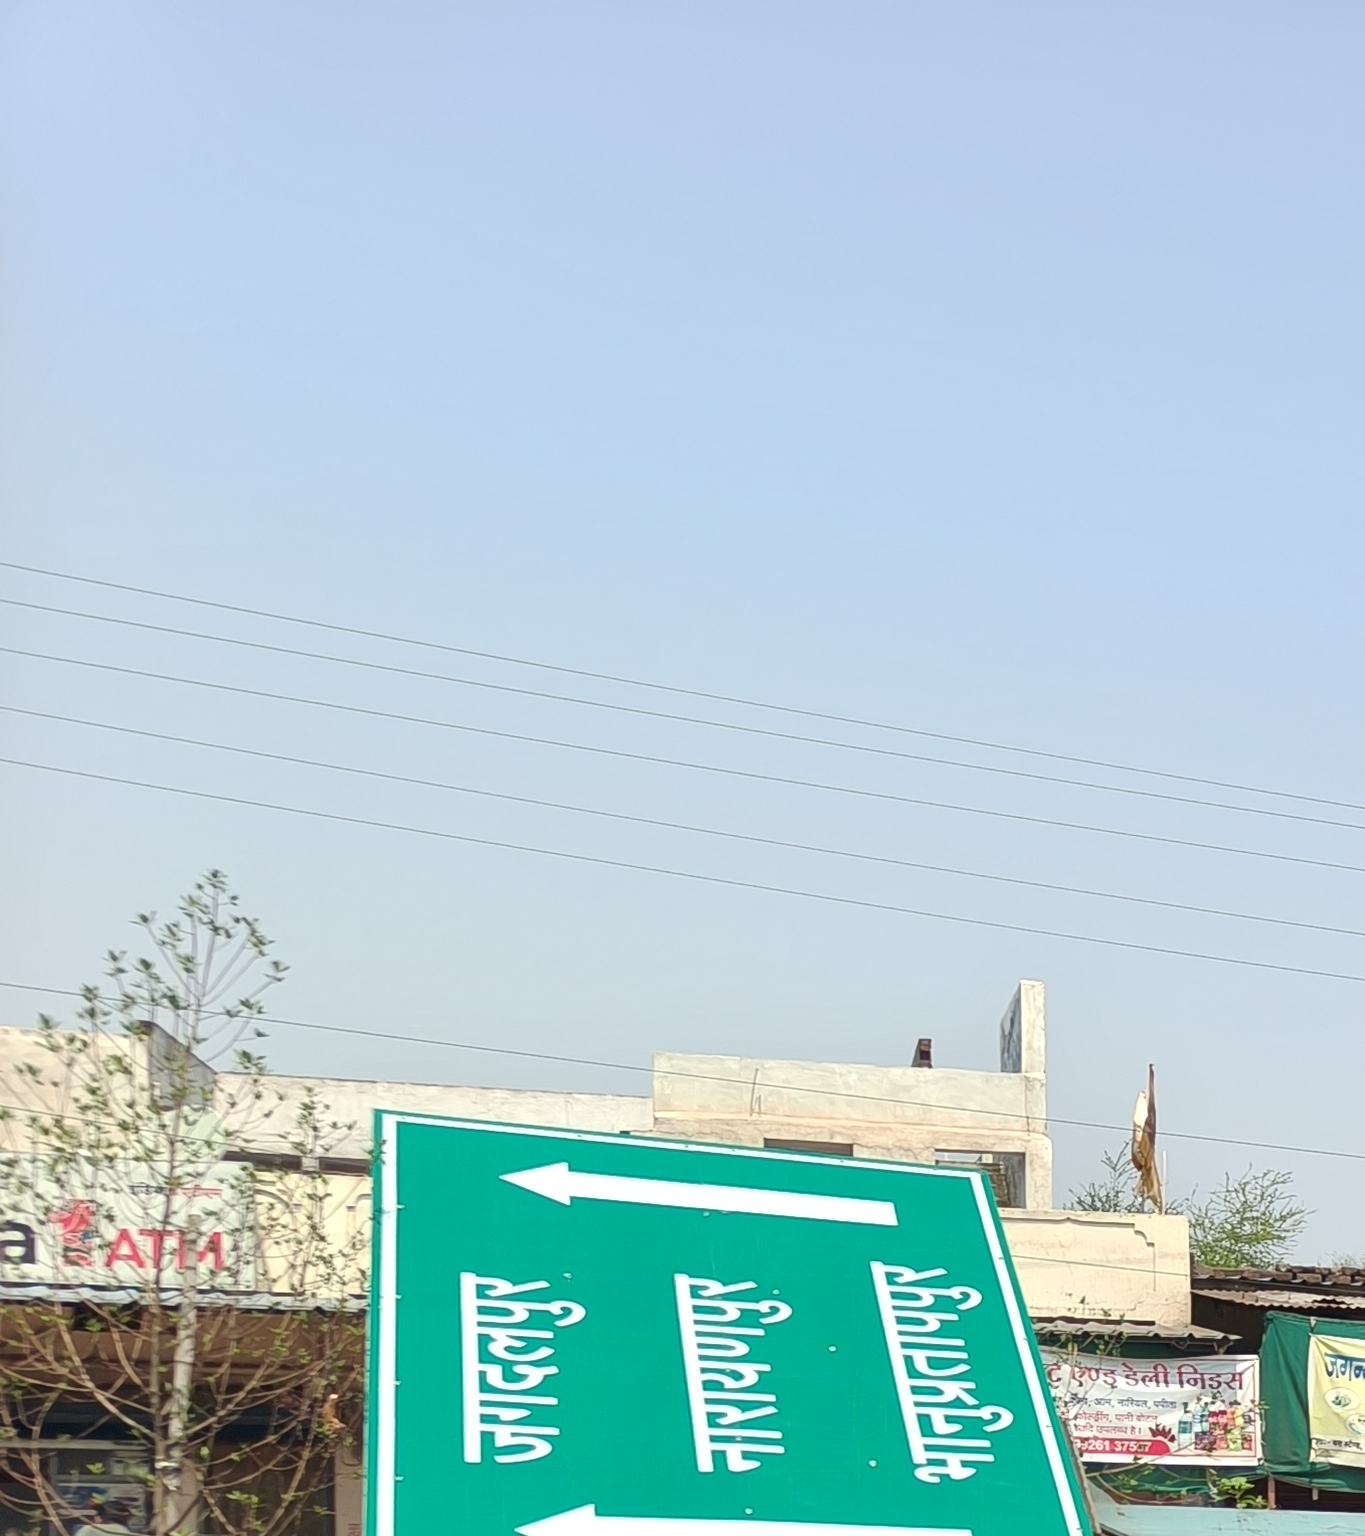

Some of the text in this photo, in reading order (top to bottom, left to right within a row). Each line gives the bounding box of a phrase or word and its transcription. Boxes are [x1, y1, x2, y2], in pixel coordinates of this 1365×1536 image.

[459, 1271, 587, 1464] जगदलपुर
[673, 1272, 793, 1473] नारायणपुर
[869, 1260, 1015, 1484] भानुप्रतापपुर
[1120, 1362, 1170, 1388] डेली
